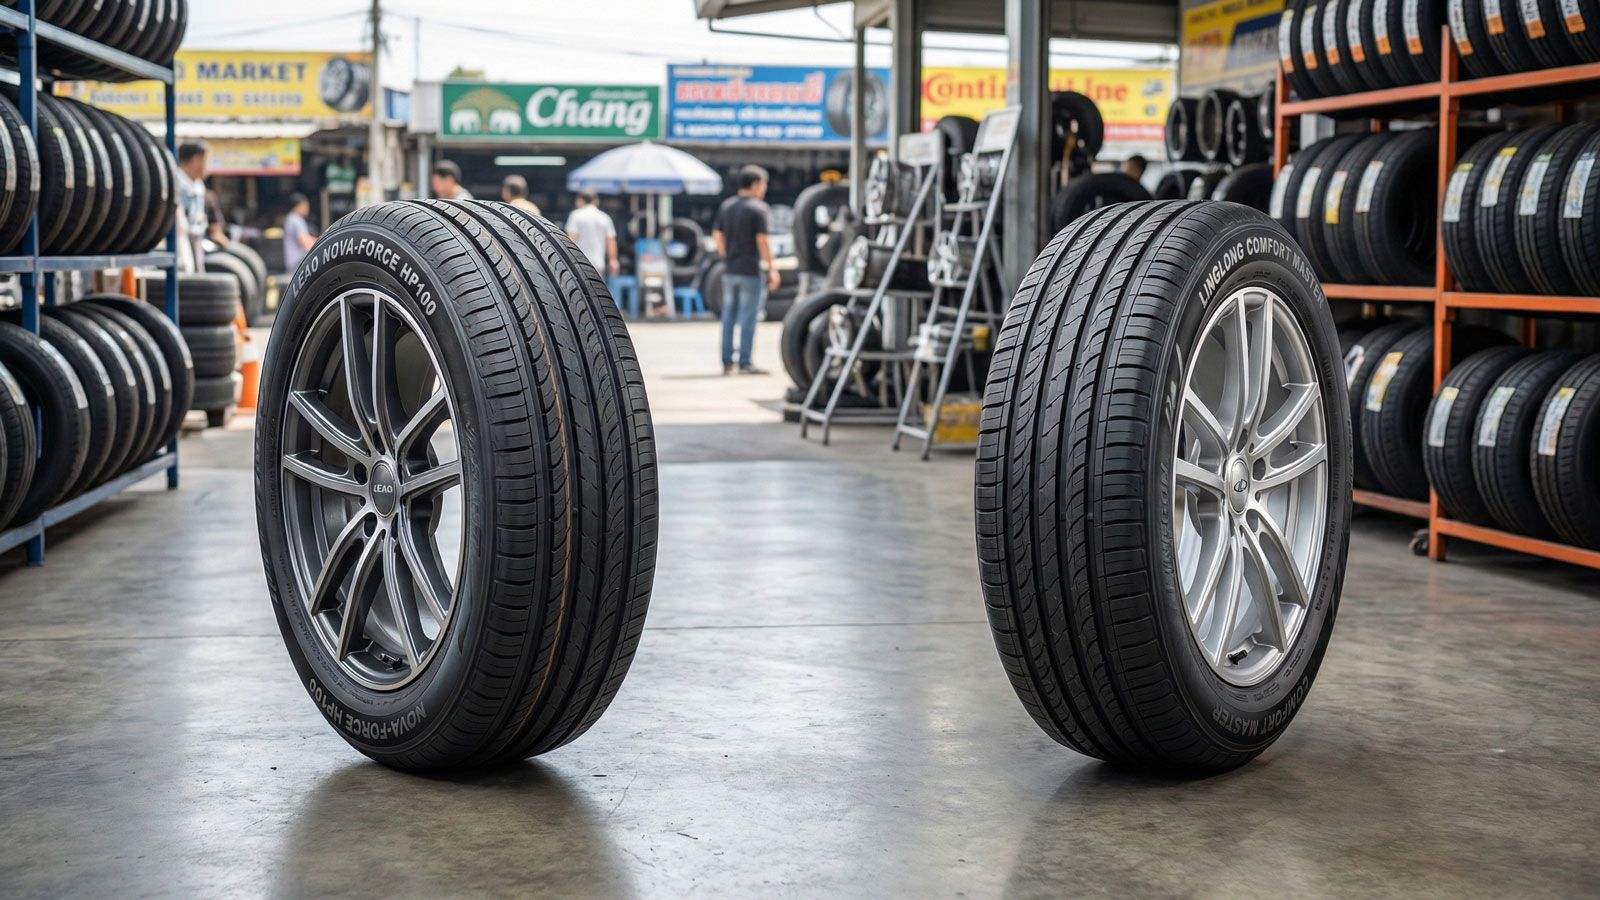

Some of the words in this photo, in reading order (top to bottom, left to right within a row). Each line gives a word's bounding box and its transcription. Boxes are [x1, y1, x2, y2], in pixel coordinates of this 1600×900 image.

[197, 62, 307, 80] MARKET
[526, 87, 653, 136] Chang
[292, 256, 319, 298] LEAO
[322, 237, 401, 271] NOVA-FORCE
[400, 263, 437, 316] HP100
[1198, 242, 1245, 309] LINGLONG
[1246, 237, 1292, 262] COMFORT
[1291, 252, 1325, 309] MASTER
[373, 484, 393, 493] LEAO
[309, 678, 343, 725] HP100
[345, 701, 428, 740] NOVA-FORCE
[1212, 702, 1259, 737] MASTER
[1260, 676, 1309, 734] COMFORT
